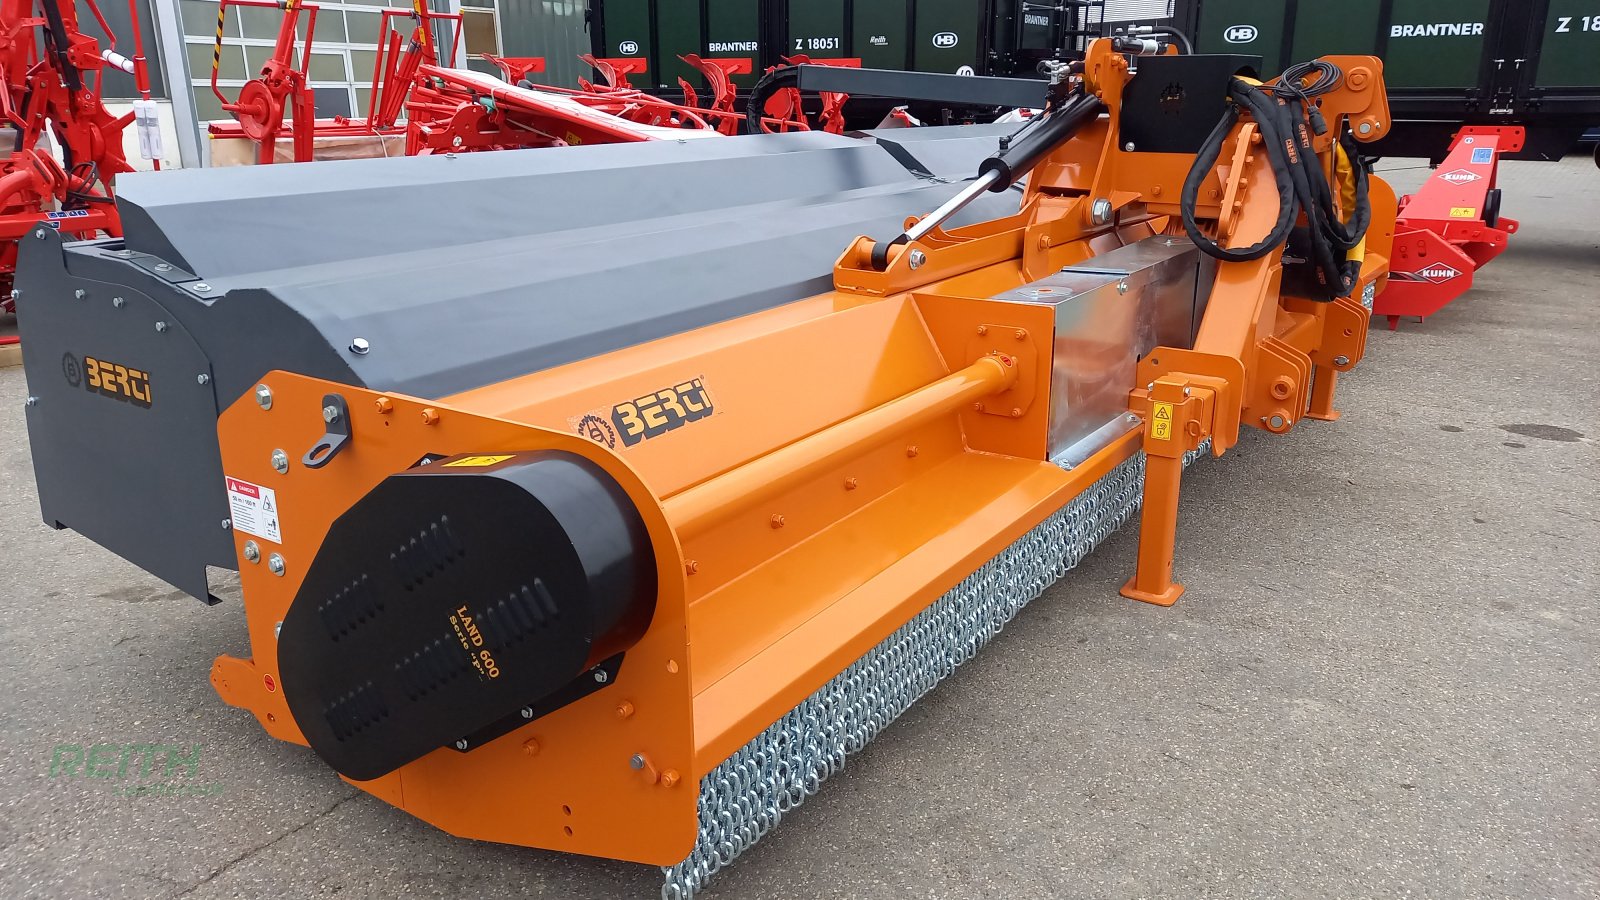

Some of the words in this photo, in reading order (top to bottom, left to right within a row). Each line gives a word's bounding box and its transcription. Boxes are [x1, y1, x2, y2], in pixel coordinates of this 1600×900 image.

[1024, 14, 1049, 26] BRANTNER
[1554, 16, 1573, 33] Z
[1228, 27, 1254, 41] HB
[1390, 22, 1484, 38] BRANTNER
[795, 38, 804, 50] Z
[807, 37, 839, 50] 18051
[936, 34, 955, 46] HB
[622, 43, 636, 52] HB
[708, 41, 758, 52] BRANTNER
[1444, 172, 1476, 181] KUHN
[1422, 269, 1455, 278] KUHN
[449, 615, 469, 650] Serie
[457, 605, 483, 647] LAND
[480, 650, 500, 678] 600
